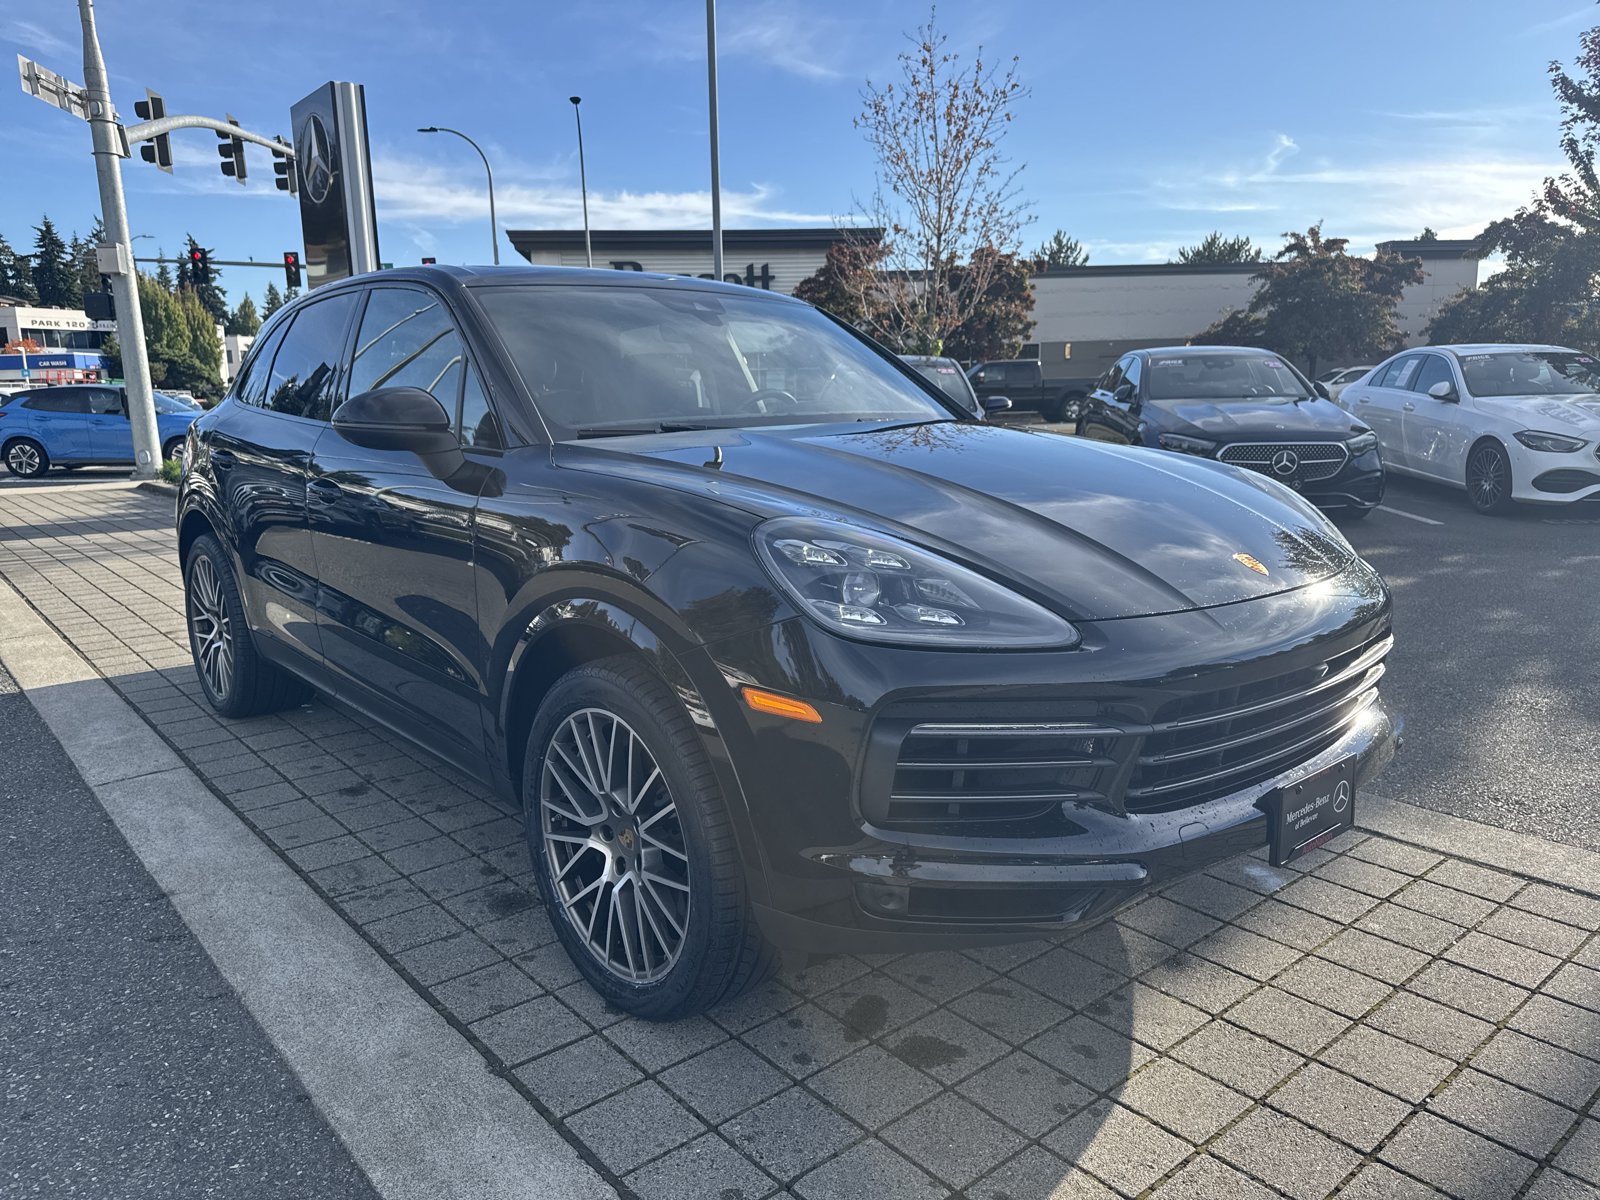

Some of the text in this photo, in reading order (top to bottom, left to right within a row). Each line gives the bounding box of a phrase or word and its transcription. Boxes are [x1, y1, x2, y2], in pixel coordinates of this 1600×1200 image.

[31, 319, 61, 327] PARK
[65, 320, 86, 328] 120
[1286, 794, 1330, 825] Mercedes-Benz
[1300, 813, 1319, 829] Bellevue
